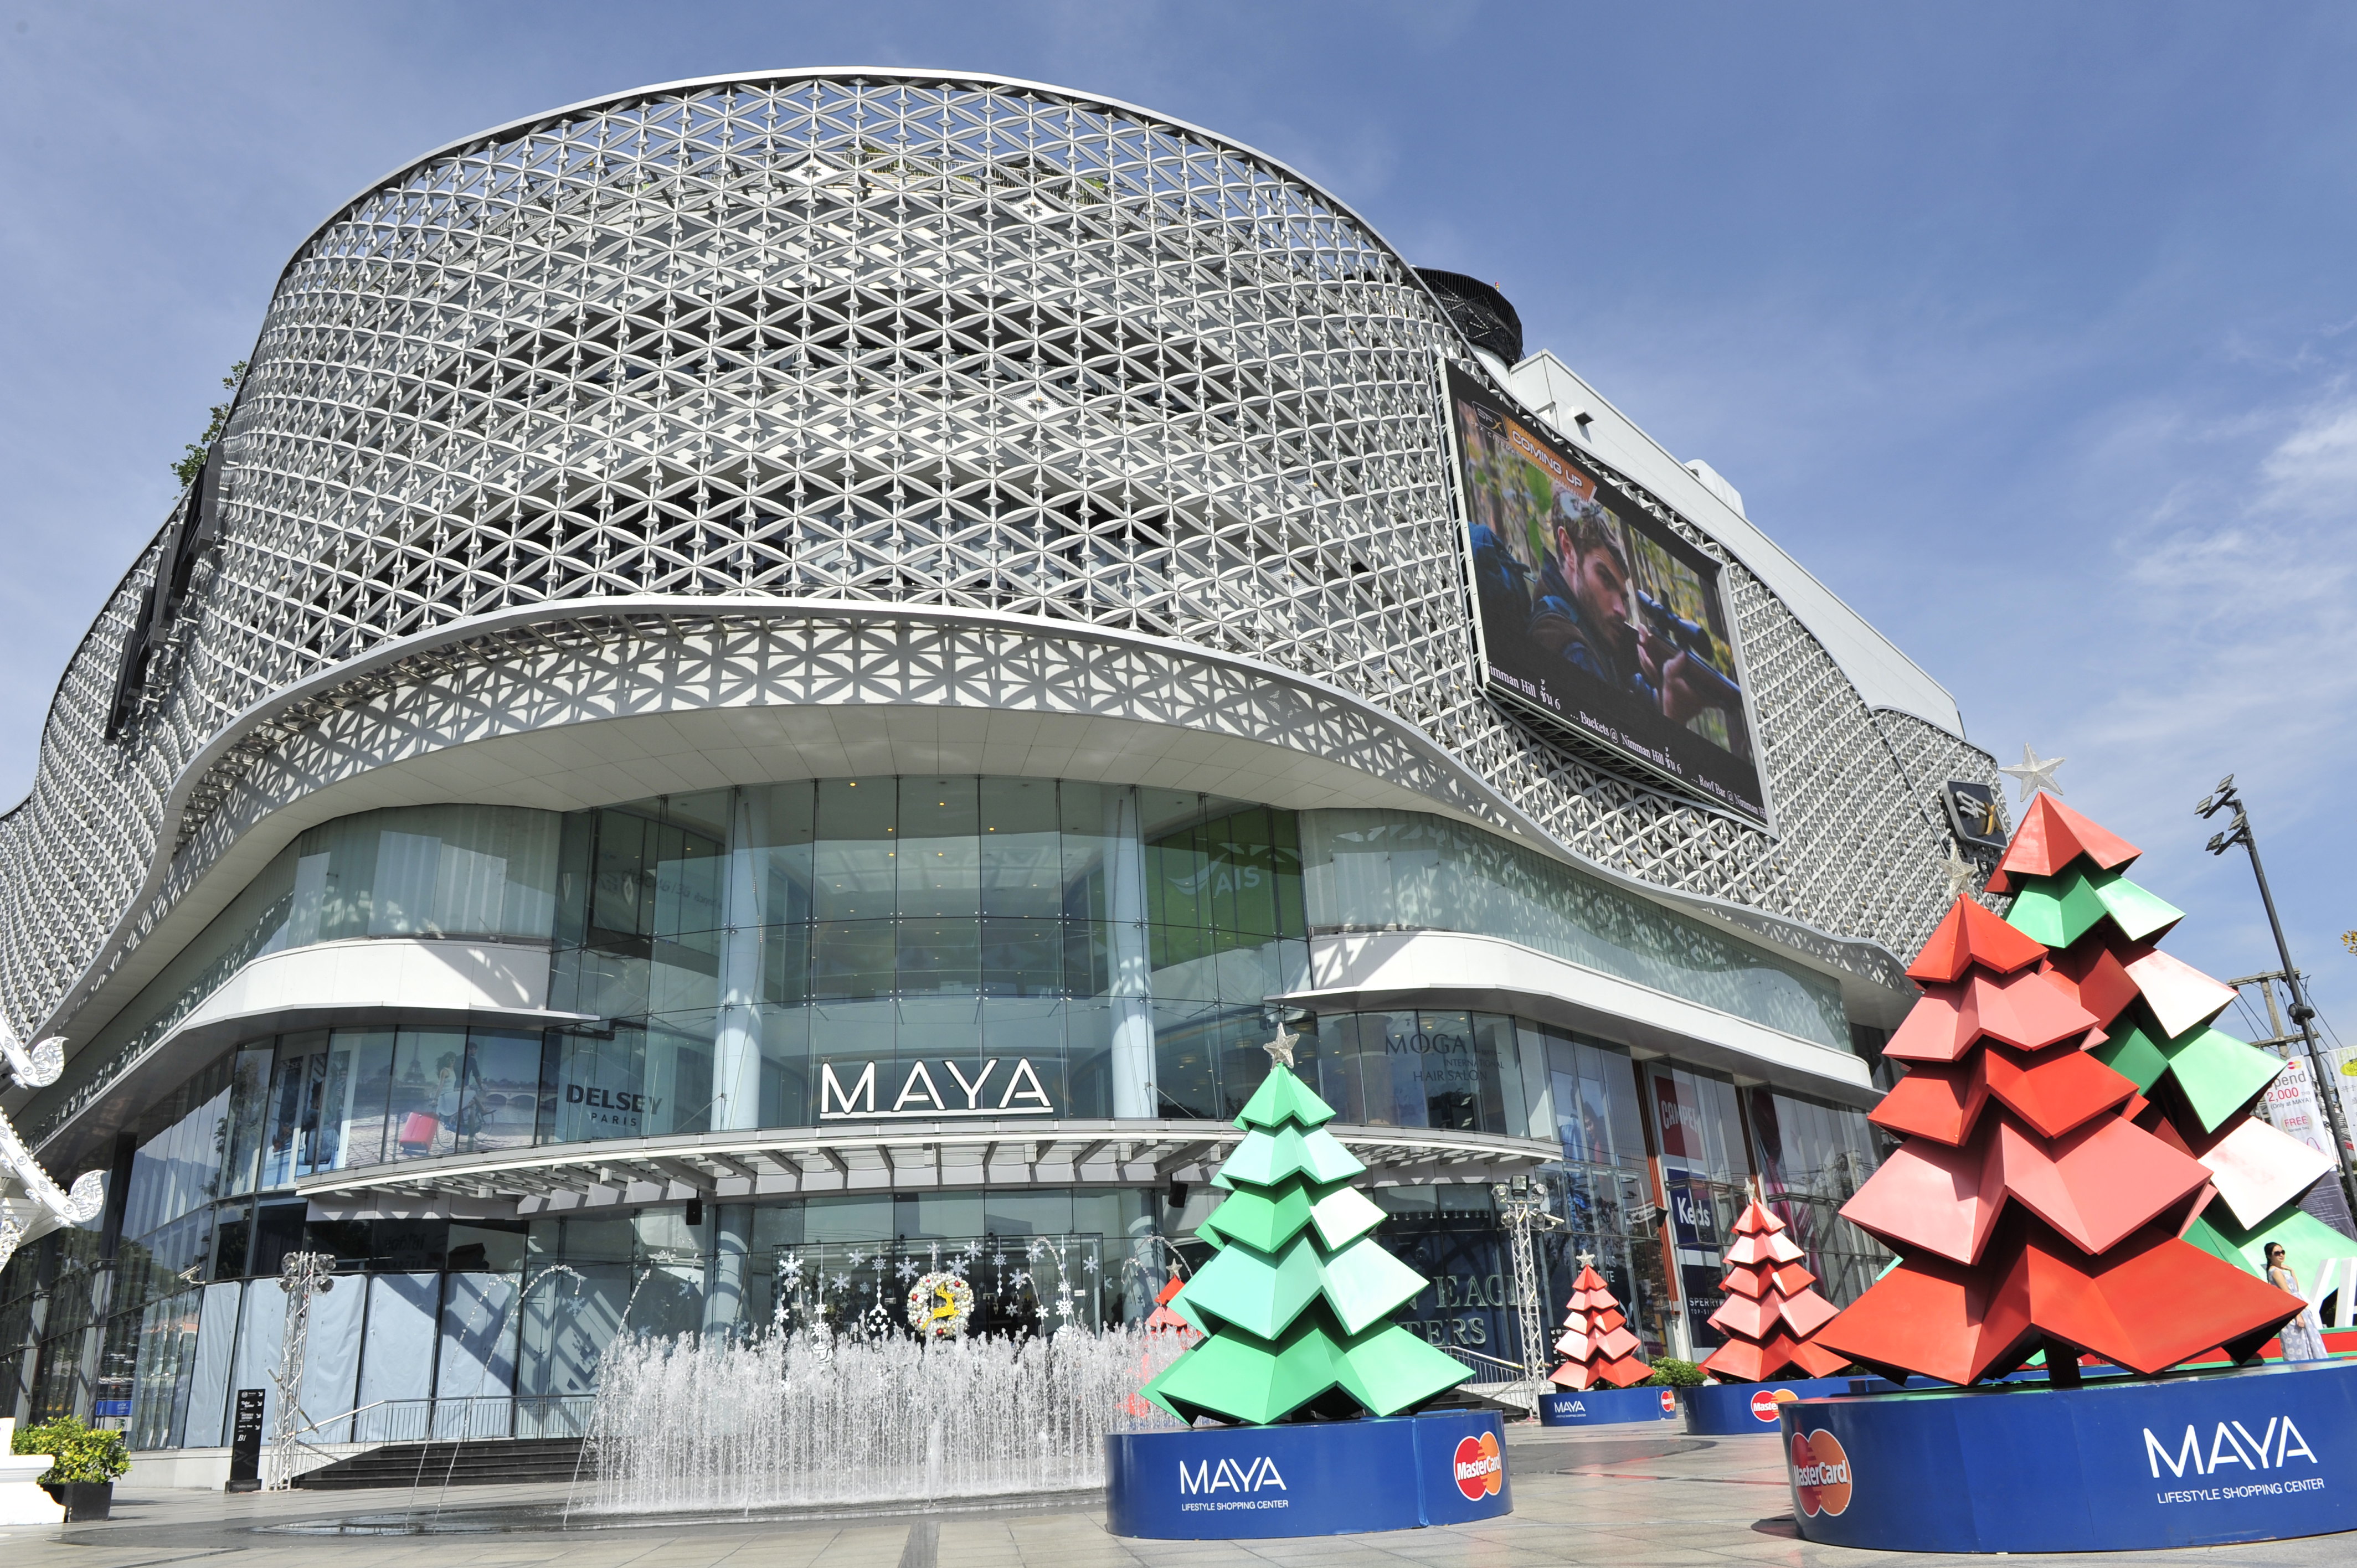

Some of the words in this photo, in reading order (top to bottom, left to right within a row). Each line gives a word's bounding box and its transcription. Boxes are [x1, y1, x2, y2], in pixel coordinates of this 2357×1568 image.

[1477, 408, 1503, 433] SFX
[1512, 430, 1562, 476] COMING
[1565, 469, 1583, 488] UP
[1488, 661, 1520, 689] imman
[1520, 678, 1537, 698] Hill
[1555, 698, 1561, 710] 6
[1579, 710, 1610, 736] Buckets
[1610, 728, 1619, 744] @
[1620, 732, 1651, 759] Nimman
[1651, 749, 1665, 766] Hill
[1676, 764, 1682, 775] 6
[1698, 774, 1715, 792] Roof
[1715, 783, 1727, 798] Bar
[1727, 790, 1735, 805] @
[1734, 793, 1759, 815] Nimman
[1956, 790, 2003, 836] SFX
[1215, 865, 1260, 897] AIS
[1385, 1033, 1468, 1055] MOGA
[1413, 1070, 1445, 1082] HAIR
[1448, 1070, 1487, 1081] SALON
[1444, 1059, 1504, 1069] INTERNATIONAL
[820, 1056, 1052, 1115] MAYA
[2267, 1087, 2299, 1102] 2,000
[566, 1084, 663, 1115] DELSEY
[2271, 1102, 2285, 1110] (Only
[2292, 1097, 2312, 1106] MAYA)
[591, 1112, 637, 1127] PARIS
[2284, 1116, 2308, 1128] FREE
[1677, 1196, 1711, 1227] Keds
[1689, 1297, 1719, 1307] SPERRY
[1554, 1400, 1586, 1414] MAYA
[1753, 1402, 1779, 1412] Maste
[2143, 1415, 2318, 1478] MAYA
[1180, 1456, 1287, 1495] MAYA
[1457, 1452, 1501, 1481] MasterCard
[1793, 1459, 1848, 1487] MasterCard
[2157, 1488, 2221, 1504] LIFESTYLE
[2222, 1482, 2283, 1499] SHOPPING
[2284, 1478, 2325, 1493] CENTER
[1181, 1502, 1215, 1512] LIFESTYLE
[1216, 1501, 1255, 1511] SHOPPING
[1257, 1499, 1289, 1509] CENTER
